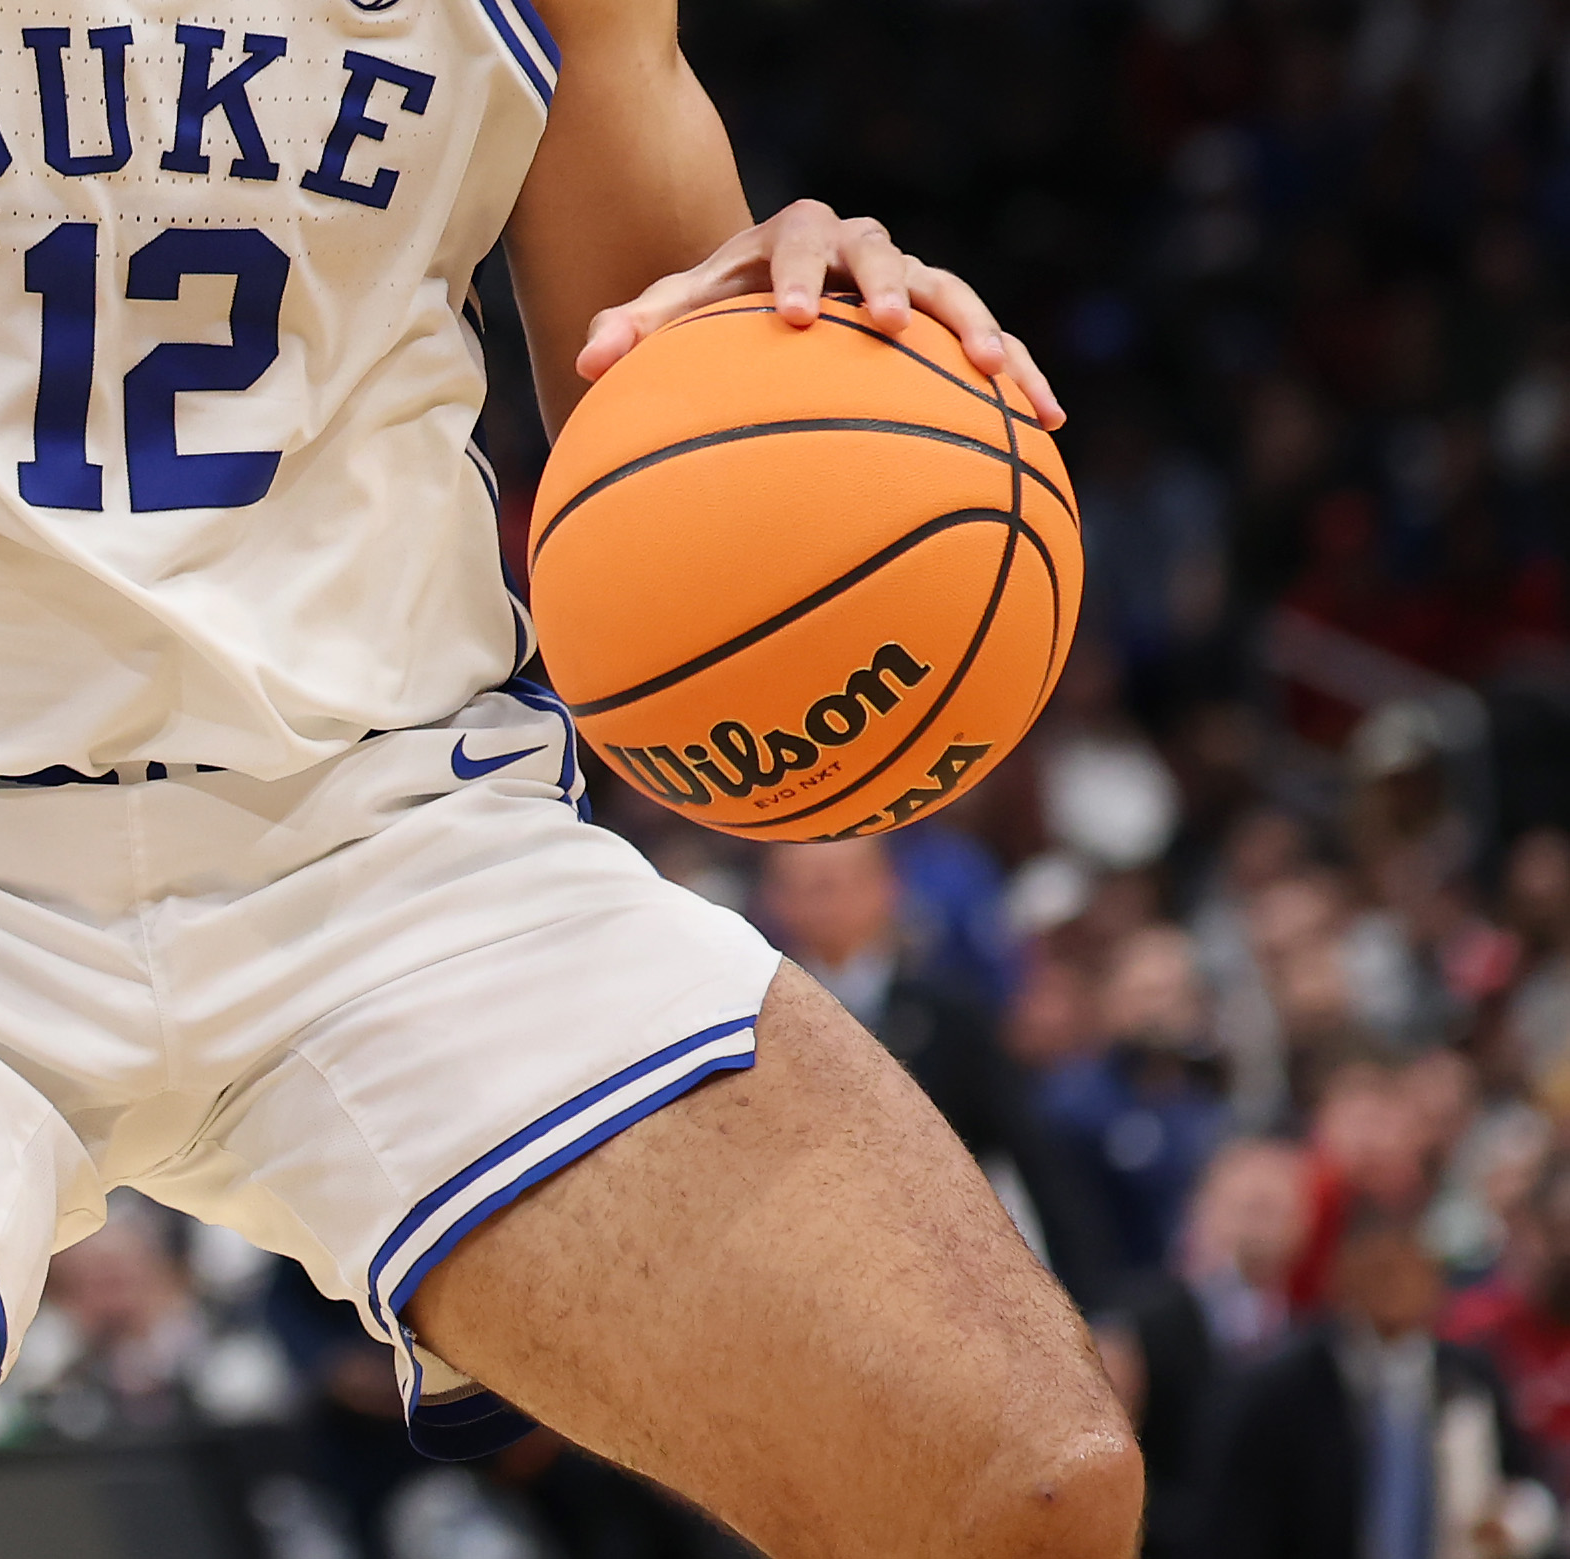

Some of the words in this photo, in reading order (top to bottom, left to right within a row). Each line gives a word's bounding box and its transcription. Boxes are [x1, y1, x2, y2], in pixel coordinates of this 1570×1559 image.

[16, 221, 292, 514] 12
[603, 640, 936, 806] Wilson
[753, 788, 797, 810] EVO
[799, 760, 844, 791] NXT
